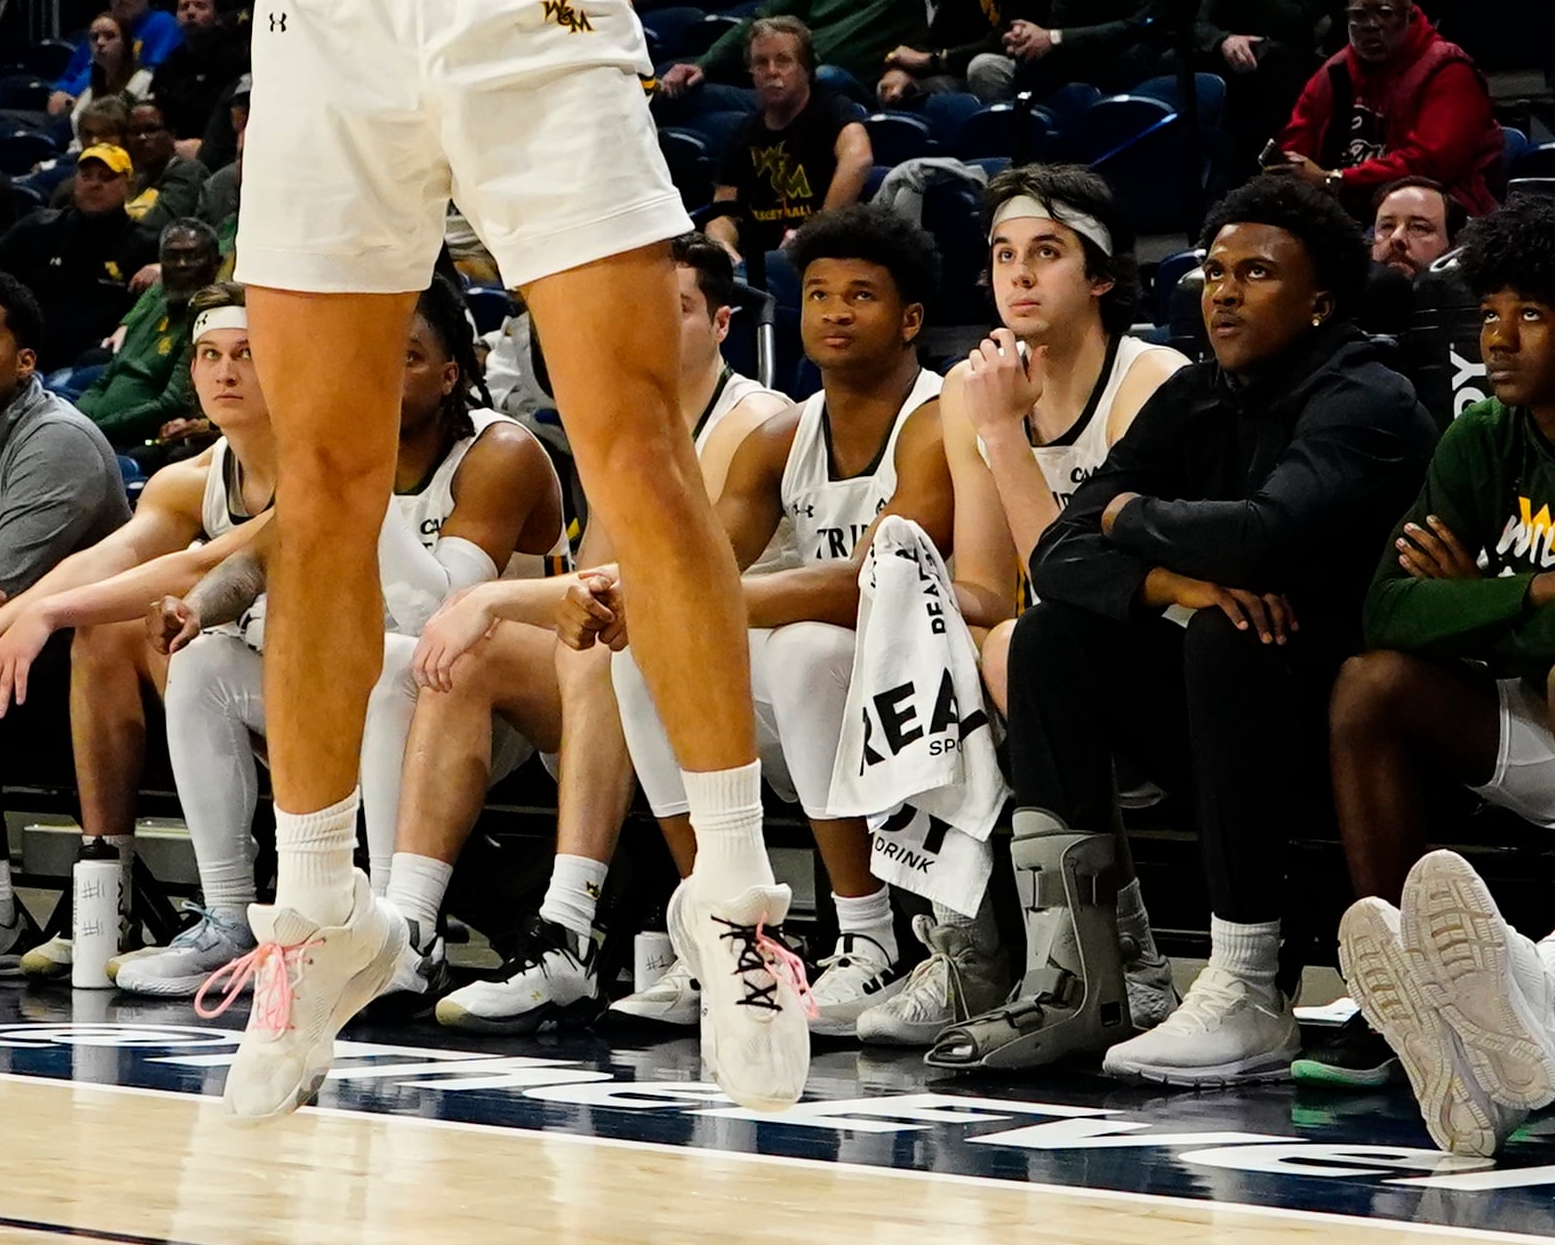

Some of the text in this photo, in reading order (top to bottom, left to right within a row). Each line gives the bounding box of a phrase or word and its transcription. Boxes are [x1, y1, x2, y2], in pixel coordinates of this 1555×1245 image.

[815, 523, 869, 560] TRI
[859, 667, 990, 777] REA
[875, 836, 935, 874] DRINK
